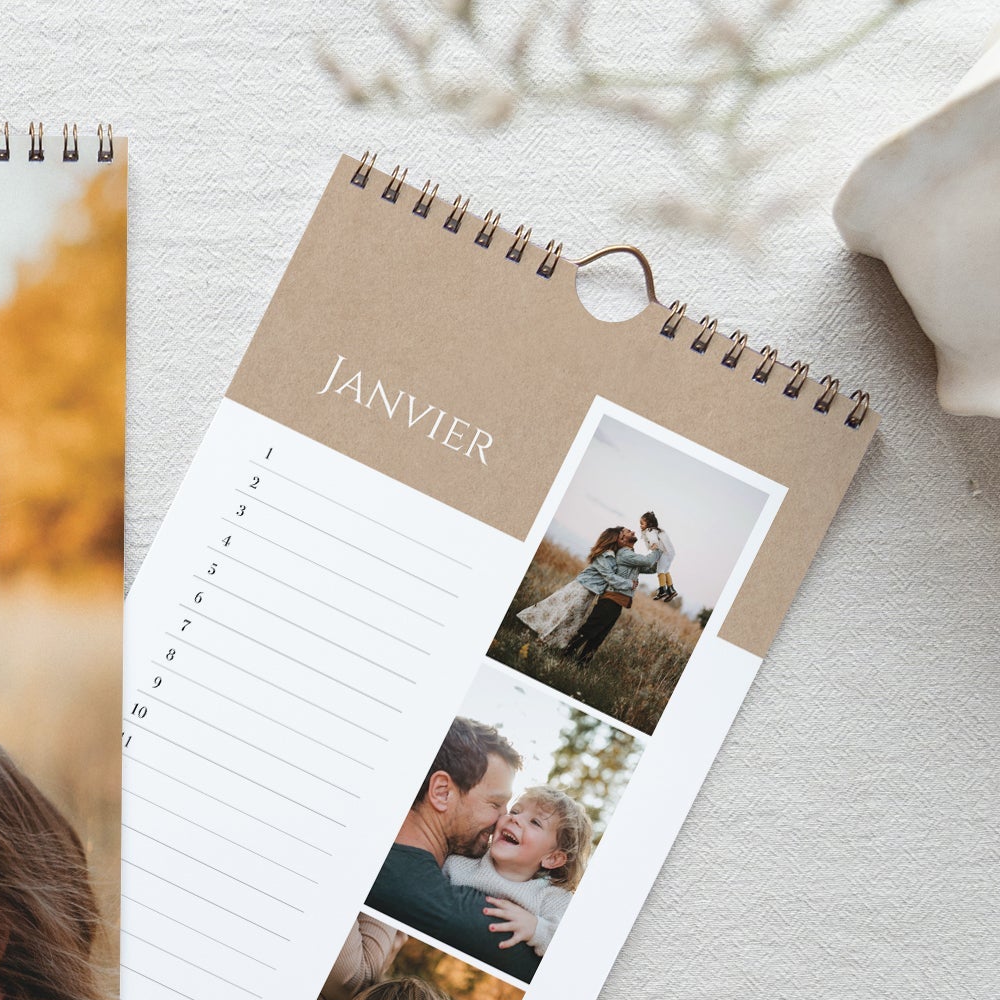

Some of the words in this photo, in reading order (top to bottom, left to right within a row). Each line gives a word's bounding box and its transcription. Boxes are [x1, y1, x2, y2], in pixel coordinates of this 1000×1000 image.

[316, 354, 494, 466] JANVIER
[264, 446, 274, 461] 1
[249, 476, 261, 490] 2
[235, 504, 247, 518] 3
[221, 534, 232, 548] 4
[207, 562, 219, 576] 5
[194, 591, 204, 605] 6
[180, 618, 192, 632] 7
[165, 648, 177, 662] 8
[151, 675, 163, 690] 9
[130, 703, 148, 719] 10
